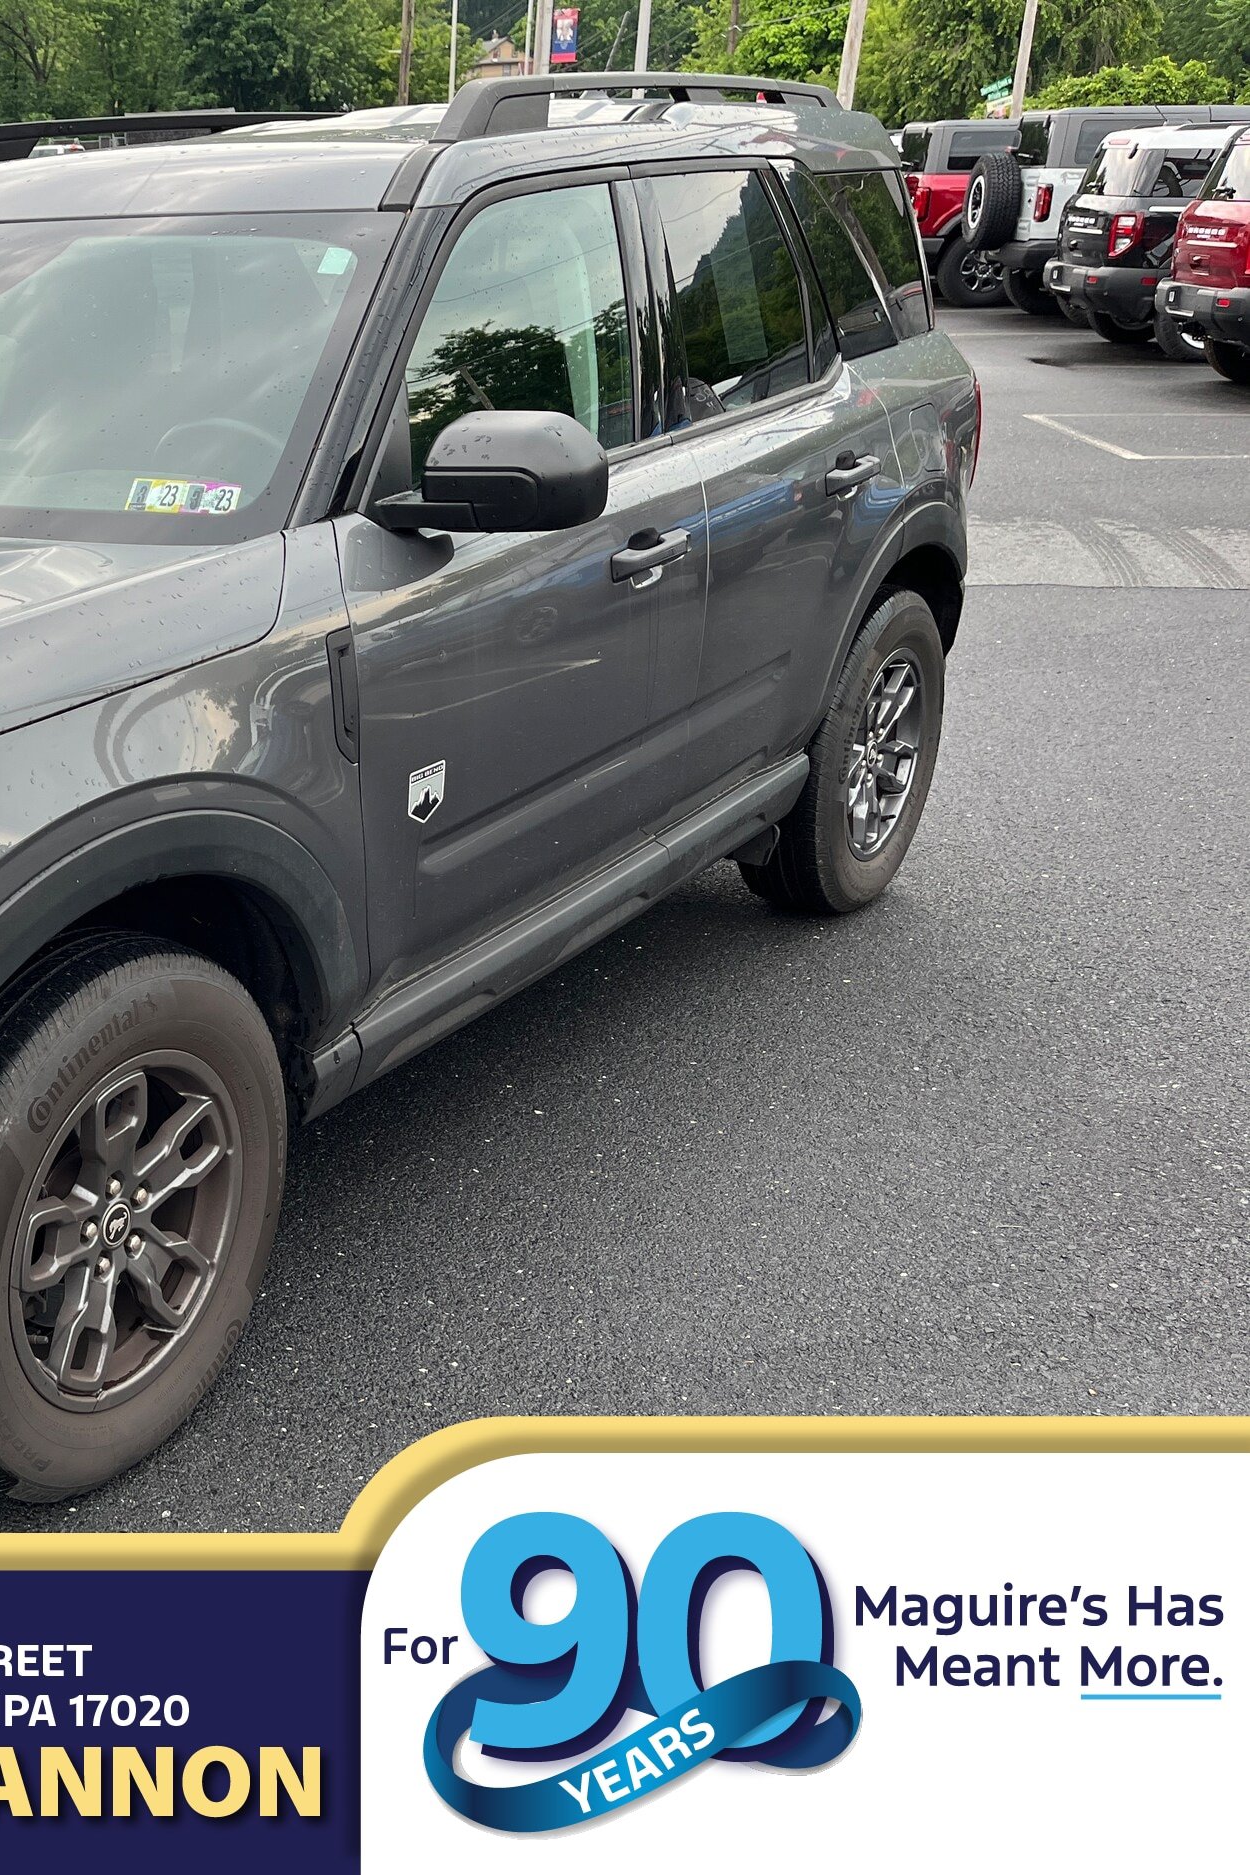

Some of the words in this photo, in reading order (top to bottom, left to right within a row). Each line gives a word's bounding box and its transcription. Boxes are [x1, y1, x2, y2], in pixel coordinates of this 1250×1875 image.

[159, 485, 179, 507] 23
[214, 489, 234, 512] 23
[411, 773, 424, 783] BIG
[424, 764, 444, 778] BEND
[27, 999, 141, 1134] Continental
